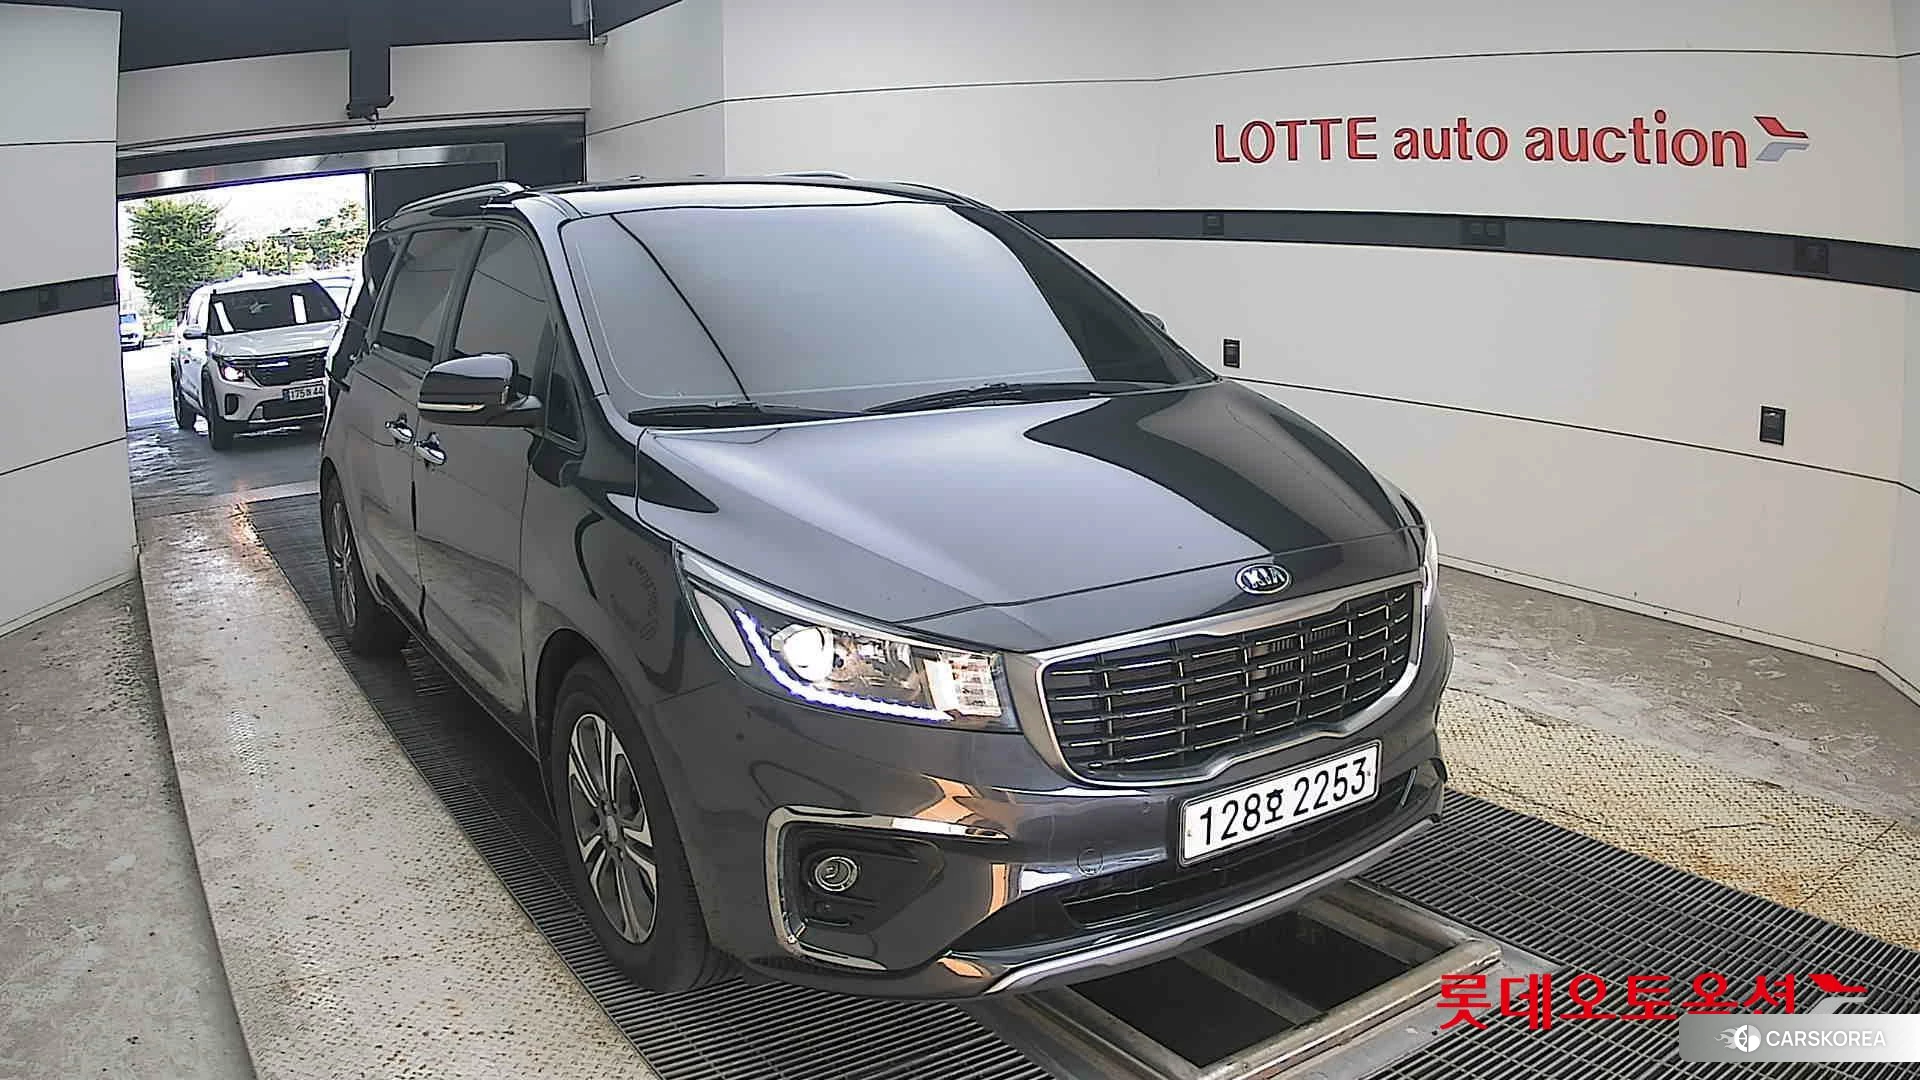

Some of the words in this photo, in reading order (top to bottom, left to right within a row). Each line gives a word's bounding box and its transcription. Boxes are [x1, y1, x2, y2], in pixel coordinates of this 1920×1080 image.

[1215, 116, 1377, 163] LOTTE
[1394, 118, 1508, 161] auto
[1524, 109, 1748, 168] auction
[1243, 567, 1286, 589] KIA
[1200, 789, 1284, 845] 128호
[1293, 756, 1367, 817] 2253
